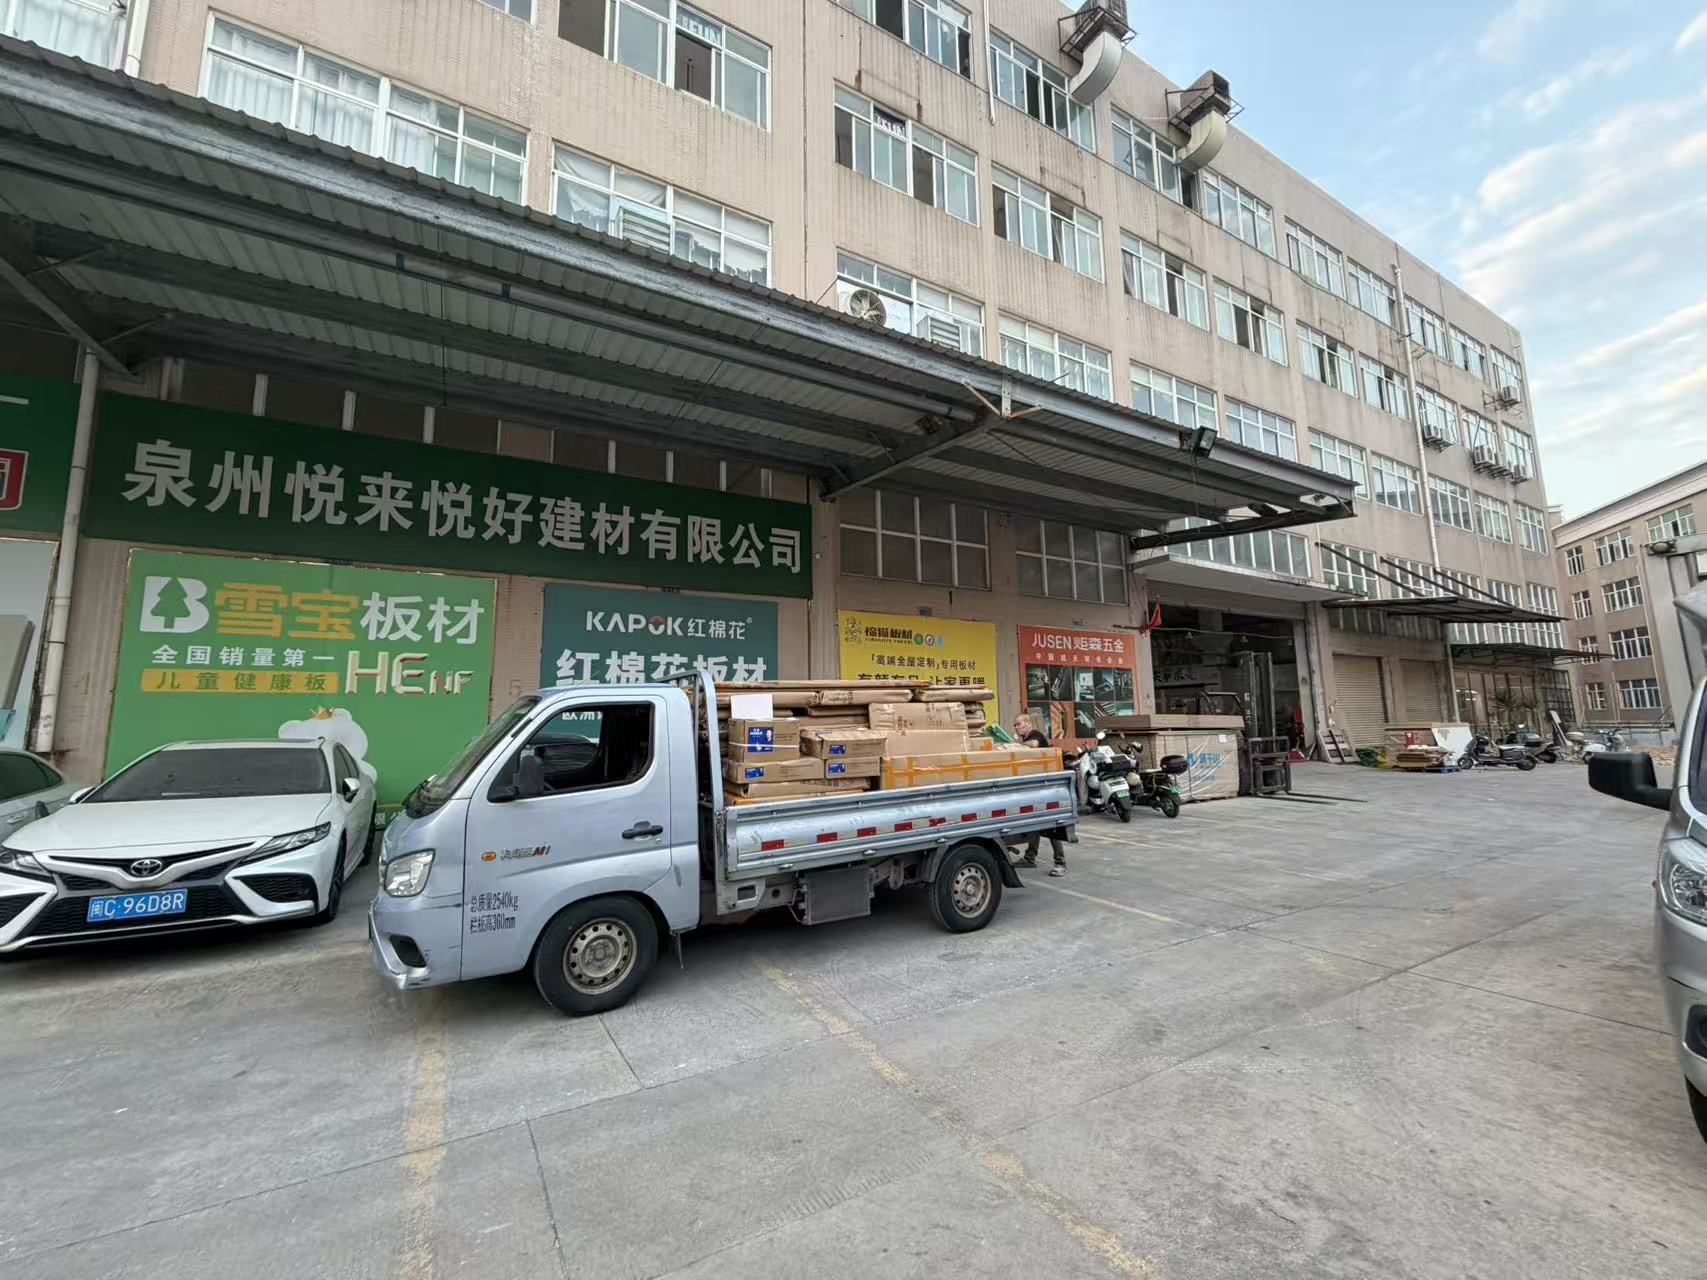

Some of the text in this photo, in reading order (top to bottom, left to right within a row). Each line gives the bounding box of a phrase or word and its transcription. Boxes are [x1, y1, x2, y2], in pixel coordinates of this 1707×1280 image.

[122, 439, 801, 573] 泉州悦来悦好建材有限公司
[215, 582, 485, 645] 雪宝板材
[586, 610, 684, 636] KAPOK
[1032, 633, 1072, 650] JUSEN
[152, 644, 335, 667] 全国销量第一
[155, 670, 327, 692] 儿童健康板
[470, 890, 519, 913] 总质量2540kg
